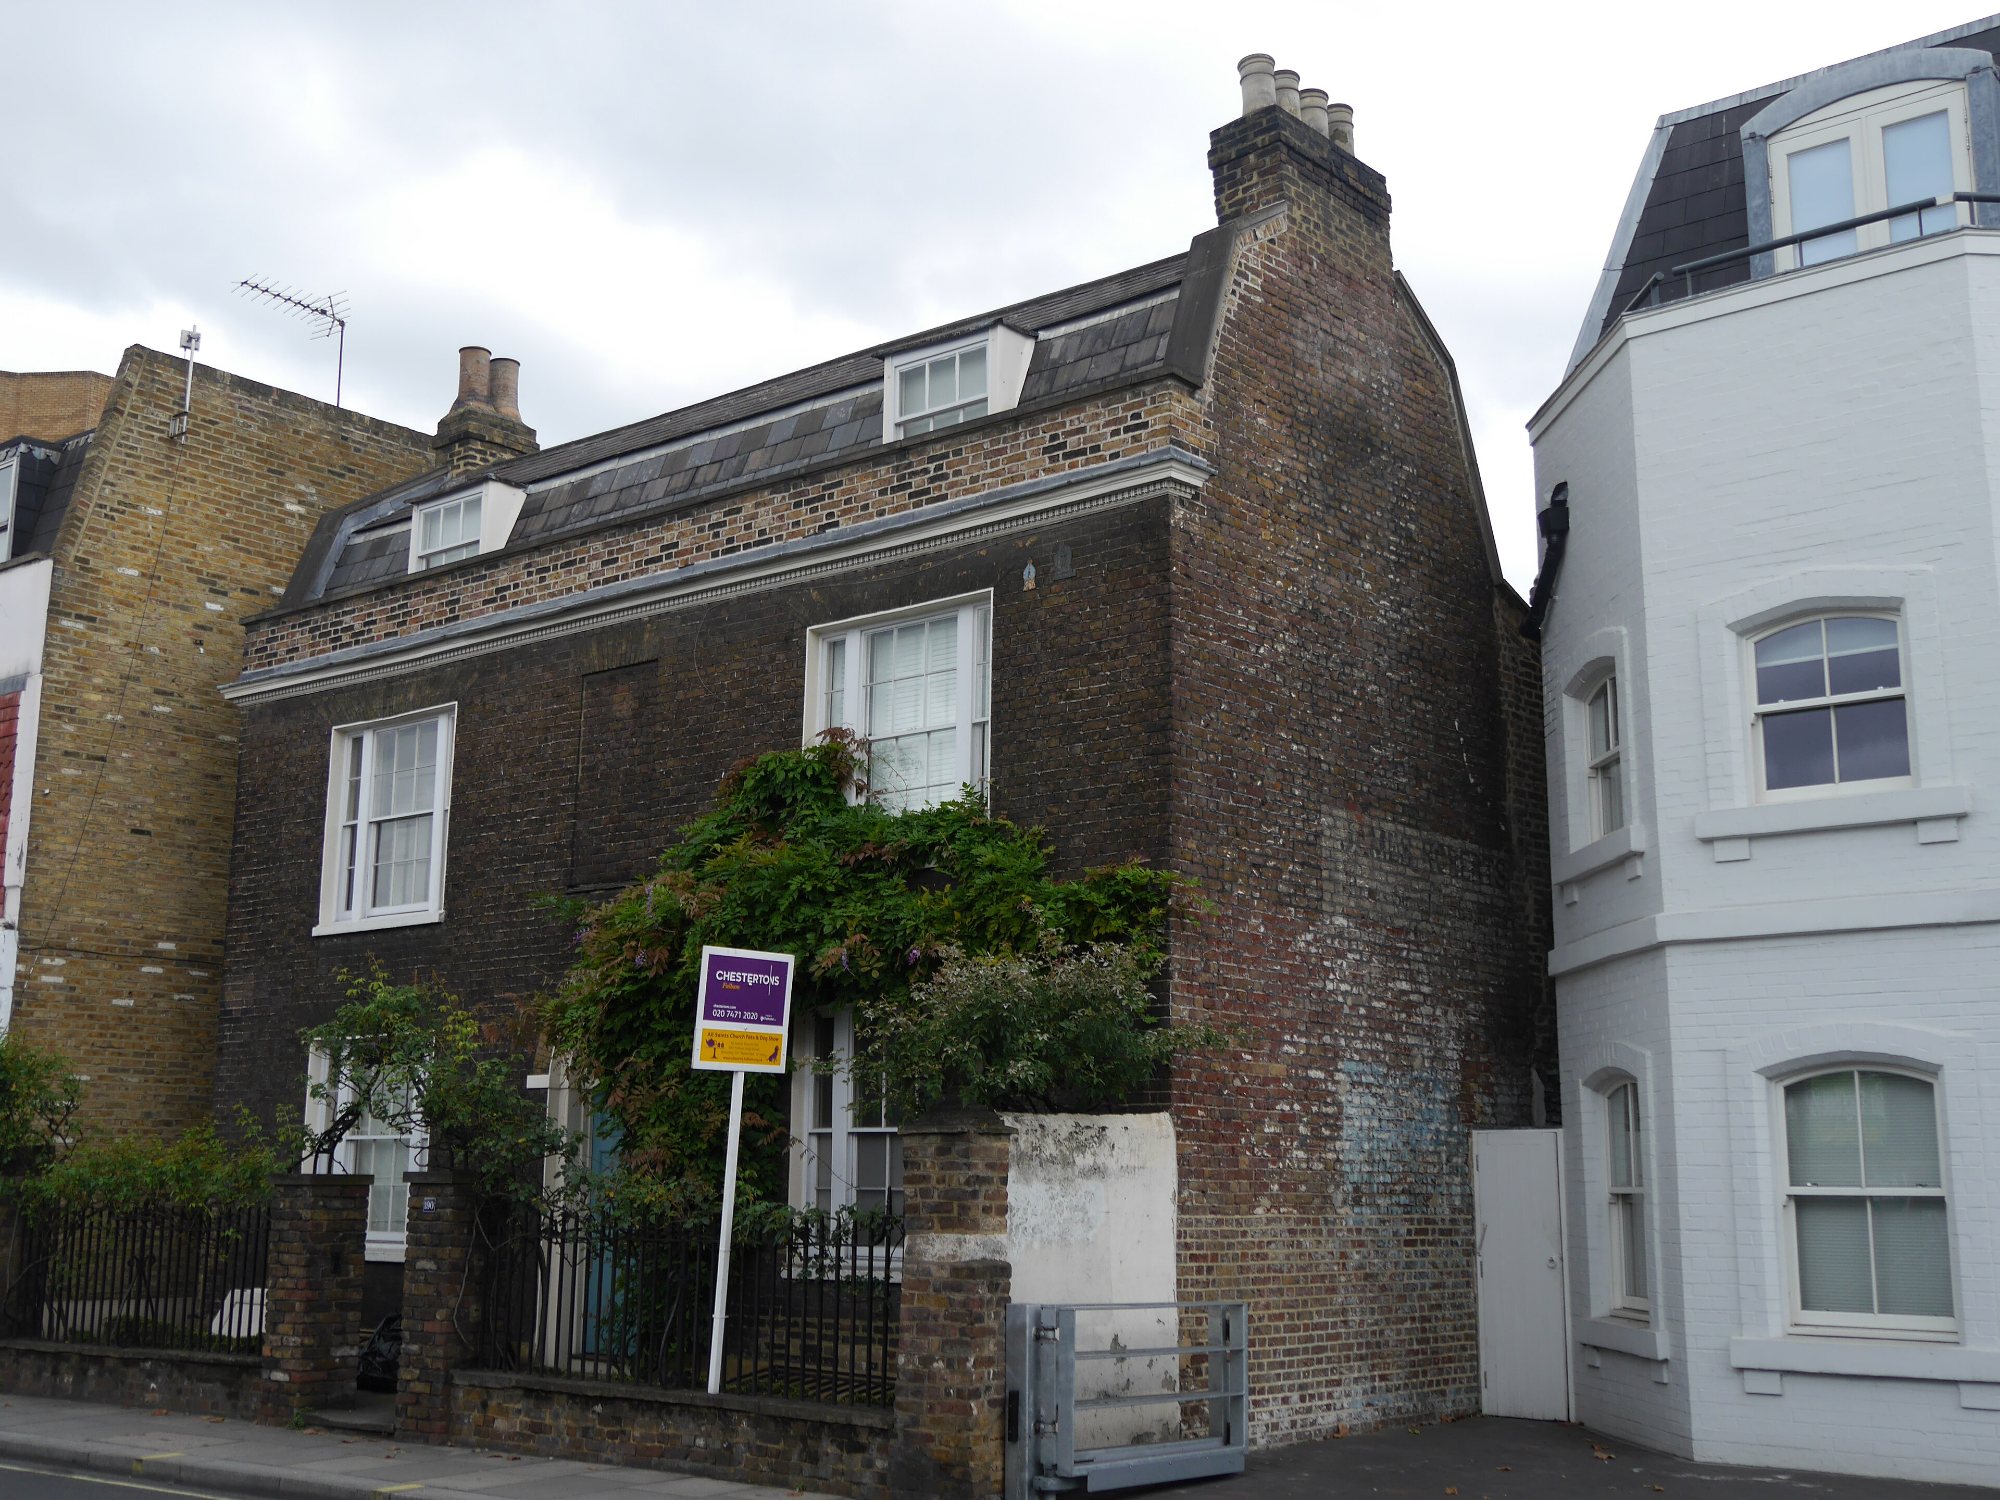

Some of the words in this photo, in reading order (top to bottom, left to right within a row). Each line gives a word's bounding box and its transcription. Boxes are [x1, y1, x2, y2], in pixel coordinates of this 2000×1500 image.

[716, 970, 780, 986] CHESTERTONS
[712, 1010, 725, 1018] 020
[726, 1010, 742, 1019] 7471
[743, 1011, 758, 1020] 2020
